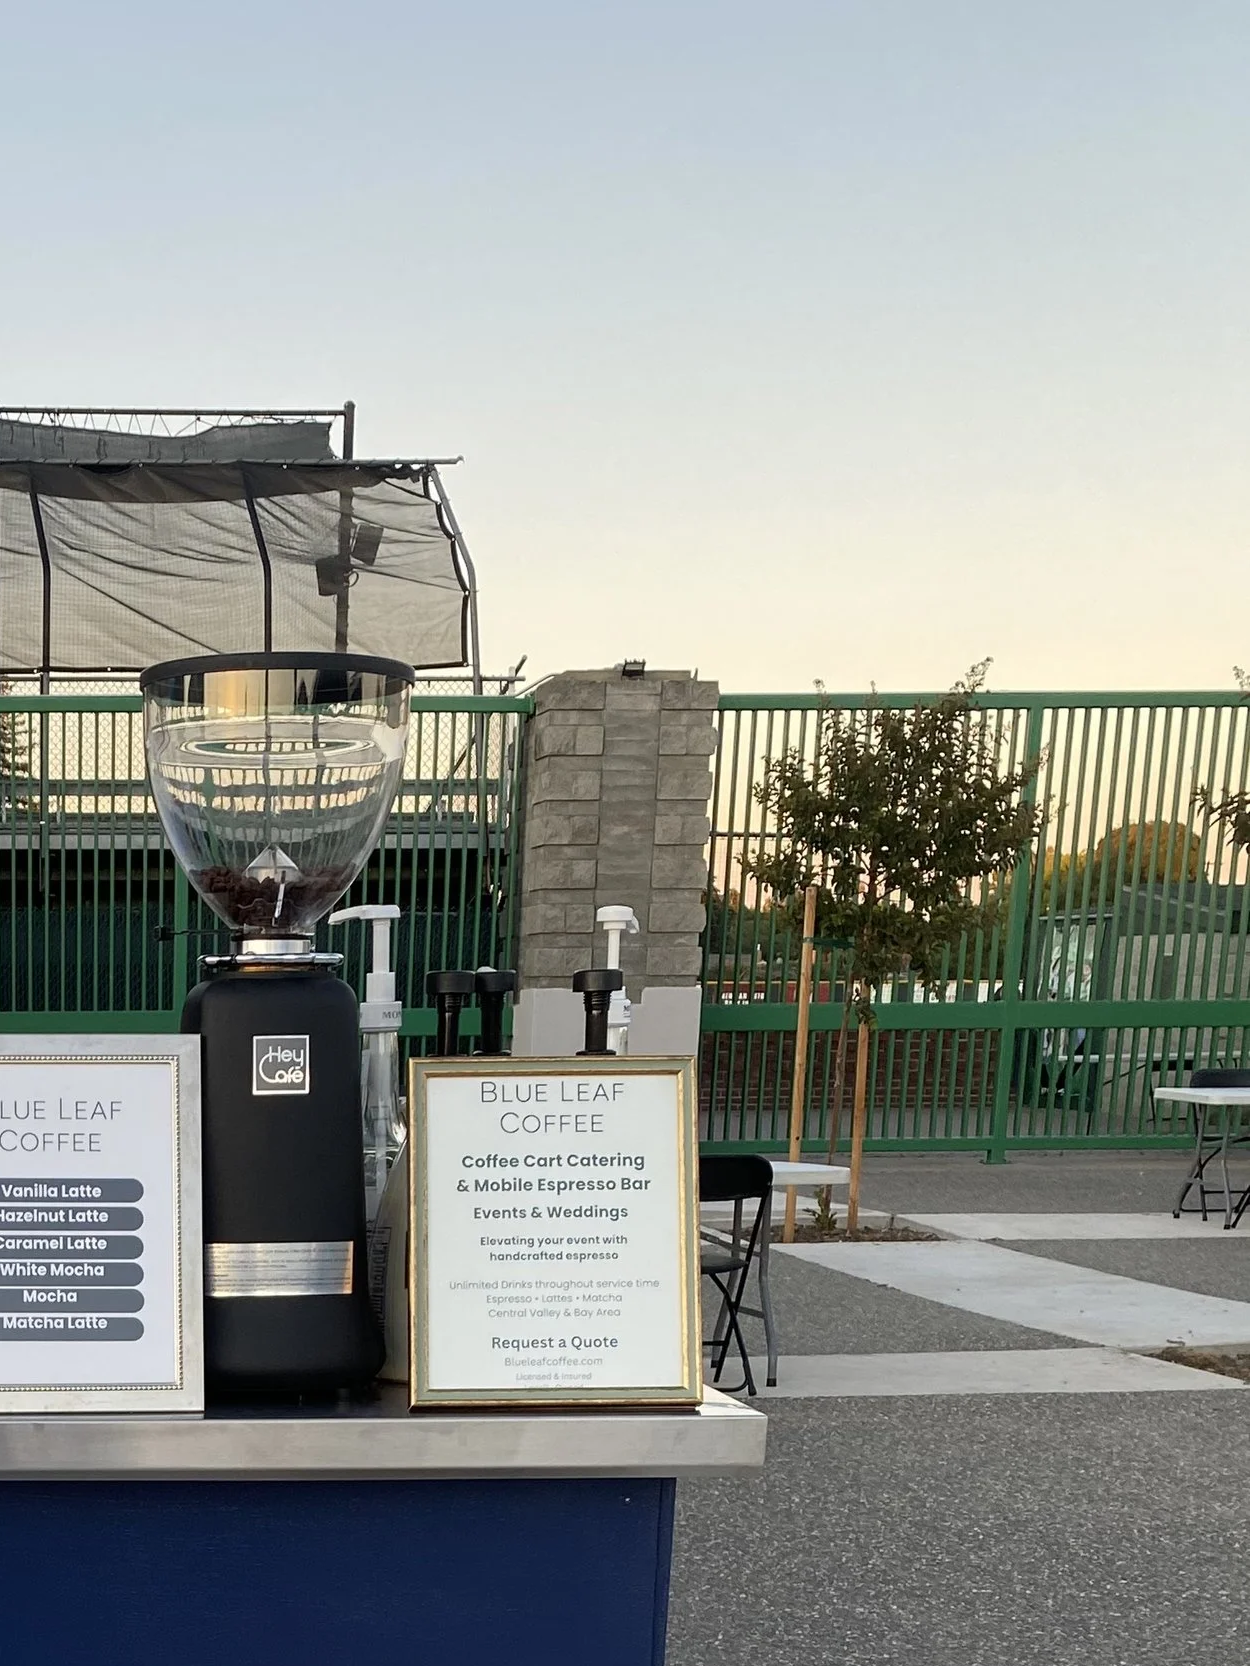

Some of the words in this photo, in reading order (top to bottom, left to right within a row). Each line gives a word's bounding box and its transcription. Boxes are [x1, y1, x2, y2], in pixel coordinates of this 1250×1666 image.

[268, 1045, 304, 1067] Hey
[480, 1081, 548, 1103] BLUE
[561, 1081, 625, 1102] LEAF
[58, 1097, 123, 1120] LEAF
[500, 1111, 604, 1134] COFFEE
[461, 1153, 519, 1168] Coffee
[523, 1154, 562, 1168] Cart
[566, 1152, 646, 1171] Catering
[1, 1183, 58, 1198] Vanilla
[61, 1184, 102, 1198] Latte
[456, 1179, 470, 1193] &
[474, 1177, 533, 1192] Mobile
[537, 1178, 616, 1195] Espresso
[620, 1177, 652, 1191] Bar
[68, 1209, 109, 1223] Latte
[473, 1206, 527, 1219] Events
[530, 1206, 543, 1219] &
[547, 1205, 629, 1222] Weddings
[66, 1237, 108, 1250] Latte
[479, 1234, 535, 1248] Elevating
[537, 1236, 565, 1248] your
[566, 1235, 601, 1245] event
[602, 1234, 628, 1245] with
[489, 1250, 563, 1261] handcrafted
[565, 1252, 619, 1263] espresso
[0, 1262, 47, 1277] White
[49, 1262, 105, 1277] Mocha
[449, 1279, 499, 1291] Unlimited
[501, 1279, 533, 1290] Drinks
[534, 1278, 594, 1291] throughout
[595, 1278, 634, 1289] service
[635, 1278, 660, 1288] time
[22, 1289, 78, 1303] Mocha
[485, 1294, 533, 1306] Espresso
[541, 1293, 574, 1304] Lattes
[582, 1293, 623, 1304] Matcha
[488, 1308, 527, 1318] Central
[529, 1308, 561, 1319] Valley
[563, 1308, 572, 1318] &
[574, 1308, 594, 1320] Bay
[595, 1307, 621, 1317] Area
[2, 1315, 65, 1329] Matcha
[67, 1315, 109, 1329] Latte
[491, 1336, 554, 1351] Request
[558, 1338, 567, 1348] a
[571, 1335, 619, 1350] Quote
[504, 1356, 603, 1367] Blueleafcoffee.com
